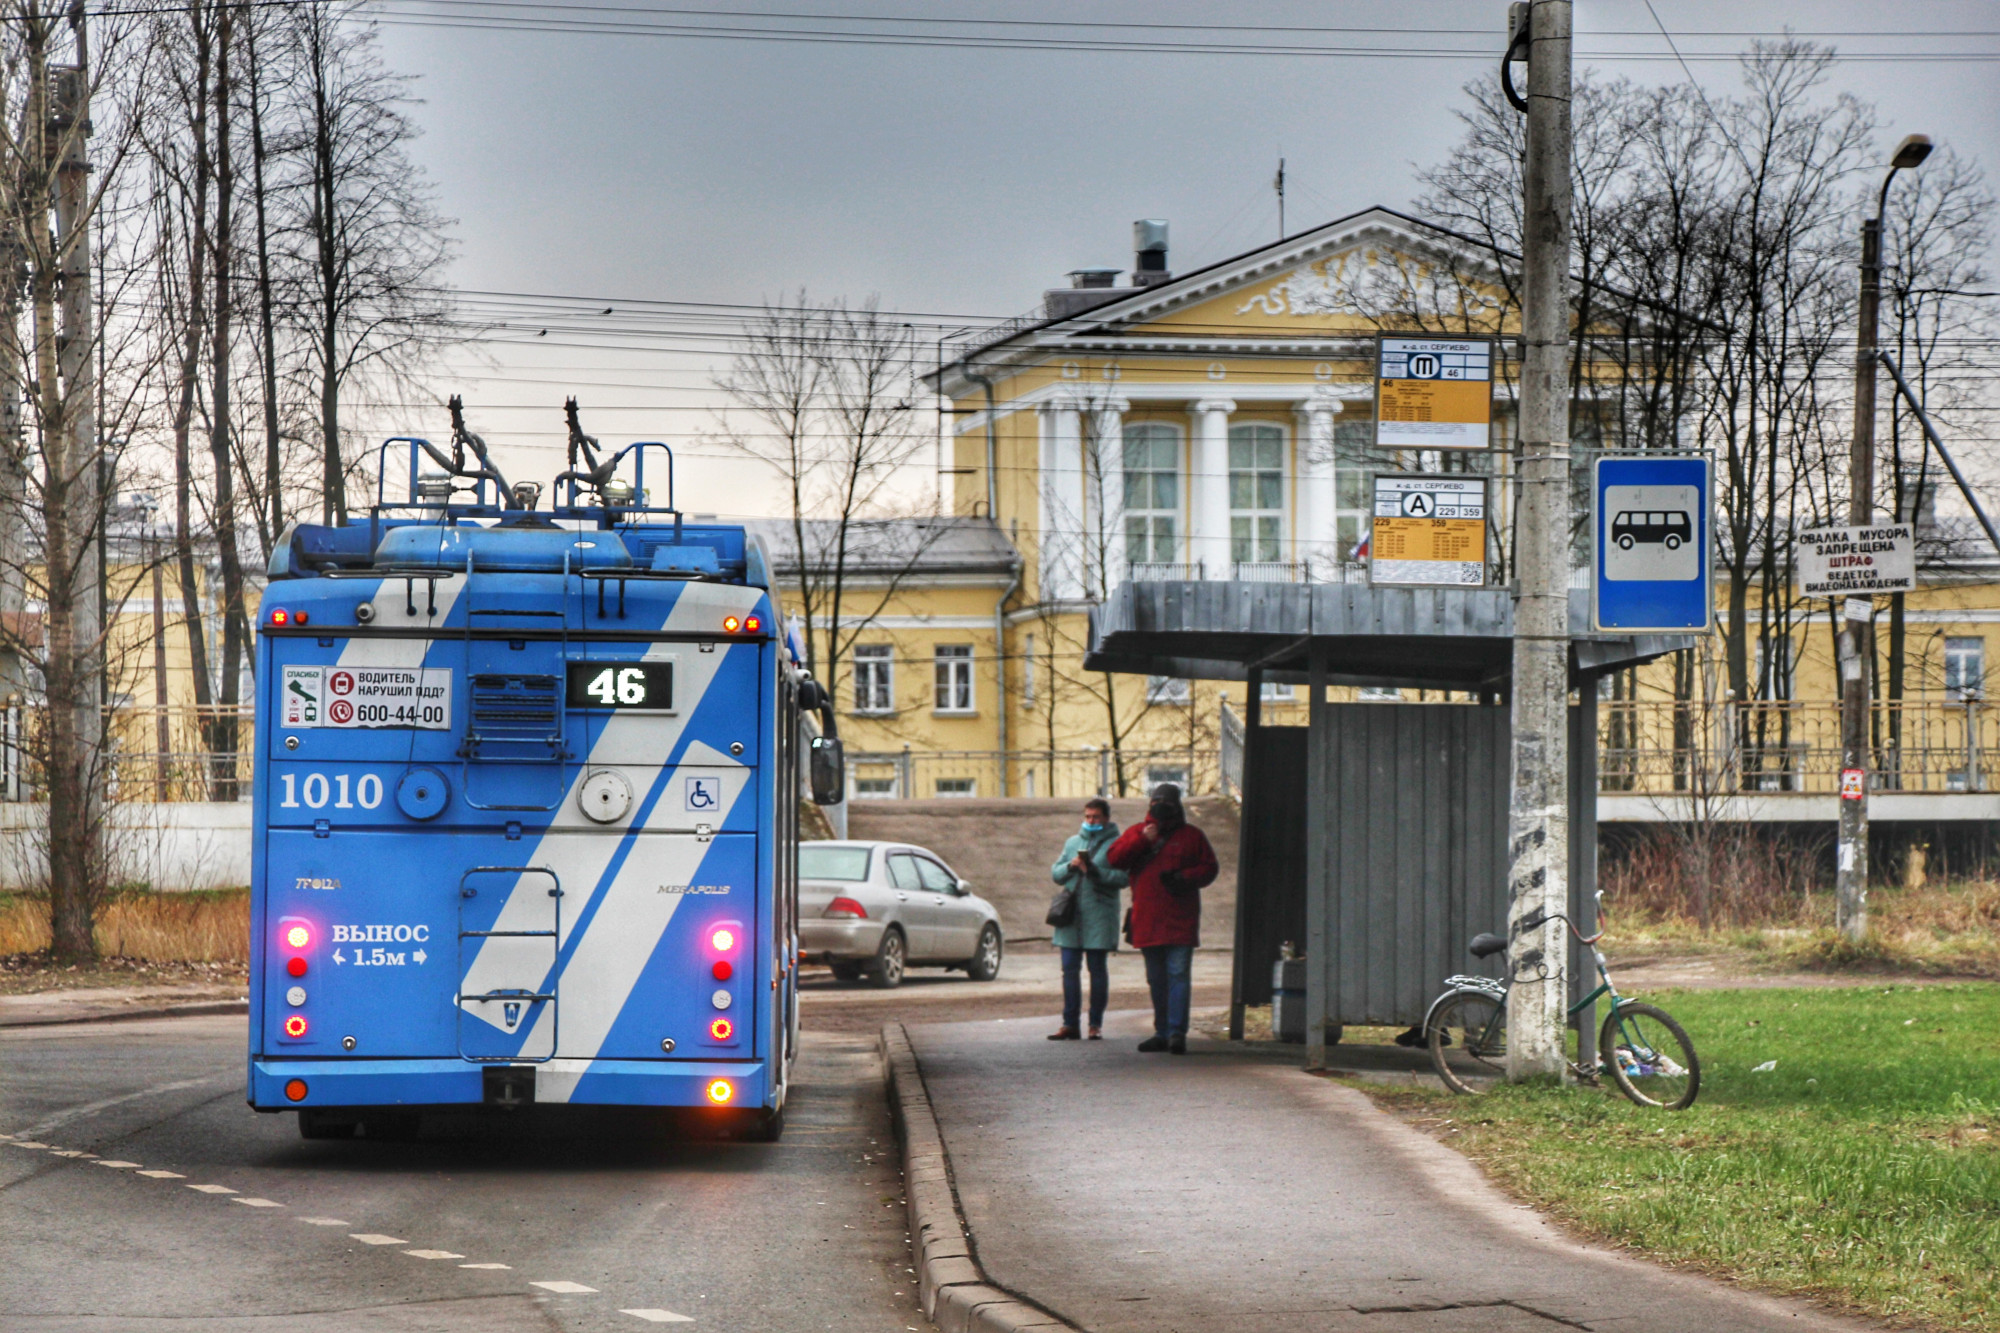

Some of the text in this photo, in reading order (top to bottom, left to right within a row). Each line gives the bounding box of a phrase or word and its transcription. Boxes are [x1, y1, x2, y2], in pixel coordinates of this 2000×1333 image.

[1431, 343, 1470, 351] СЕРГИЕВО
[1447, 369, 1459, 377] 46
[1383, 380, 1394, 388] 46
[1425, 482, 1464, 490] СЕРГИЕВО
[1439, 507, 1456, 516] 229
[1463, 508, 1480, 516] 359
[1375, 518, 1390, 526] 229
[1431, 519, 1446, 527] 359
[1799, 527, 1909, 544] СВАЛКА МУСОРА
[1816, 541, 1896, 555] ЗАПРЕЩЕНА
[1829, 556, 1873, 568] ШТРАФ
[1828, 569, 1878, 581] ВЕДЕТСЯ
[1805, 578, 1910, 592] ВИДЕОНАБЛЮДЕНИЕ
[358, 672, 415, 684] ВОДИТЕЛЬ
[358, 685, 445, 698] НАРУШИЛ ПДД?
[587, 667, 646, 705] 46
[357, 704, 444, 723] 600-44-00
[280, 773, 384, 809] 1010
[657, 885, 731, 895] MEGAPOLIS
[332, 924, 430, 943] ВЫНОС
